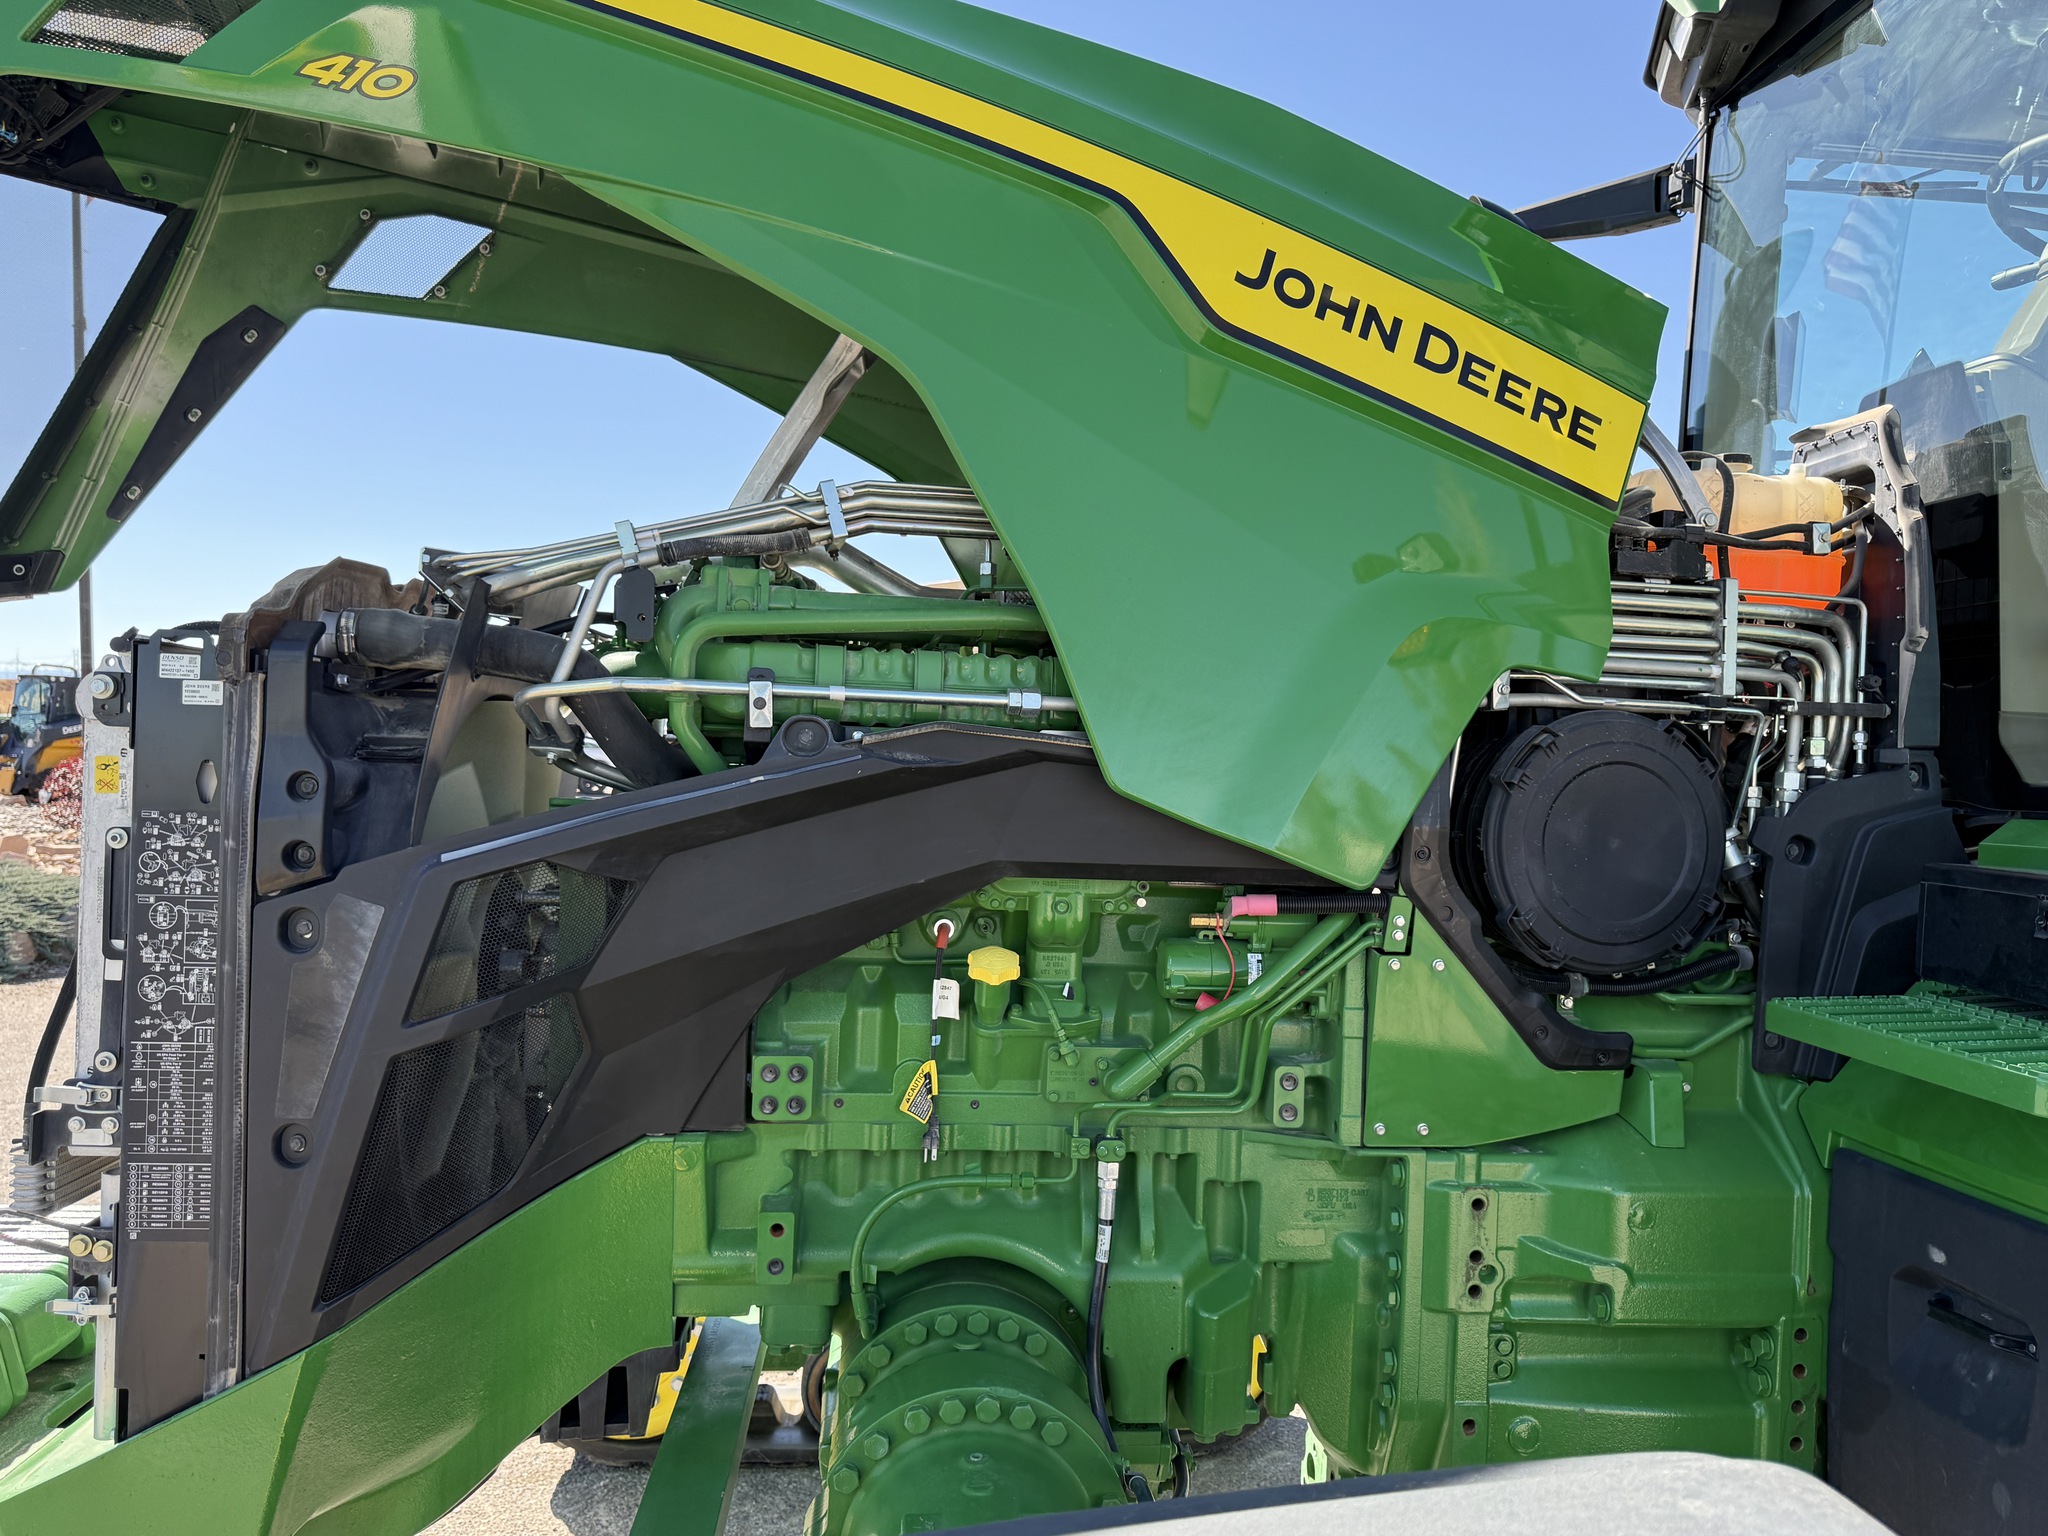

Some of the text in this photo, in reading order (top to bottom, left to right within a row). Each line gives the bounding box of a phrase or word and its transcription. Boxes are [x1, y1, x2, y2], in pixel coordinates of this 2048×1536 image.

[298, 54, 416, 99] 410
[1234, 248, 1603, 451] JOHN DEERE
